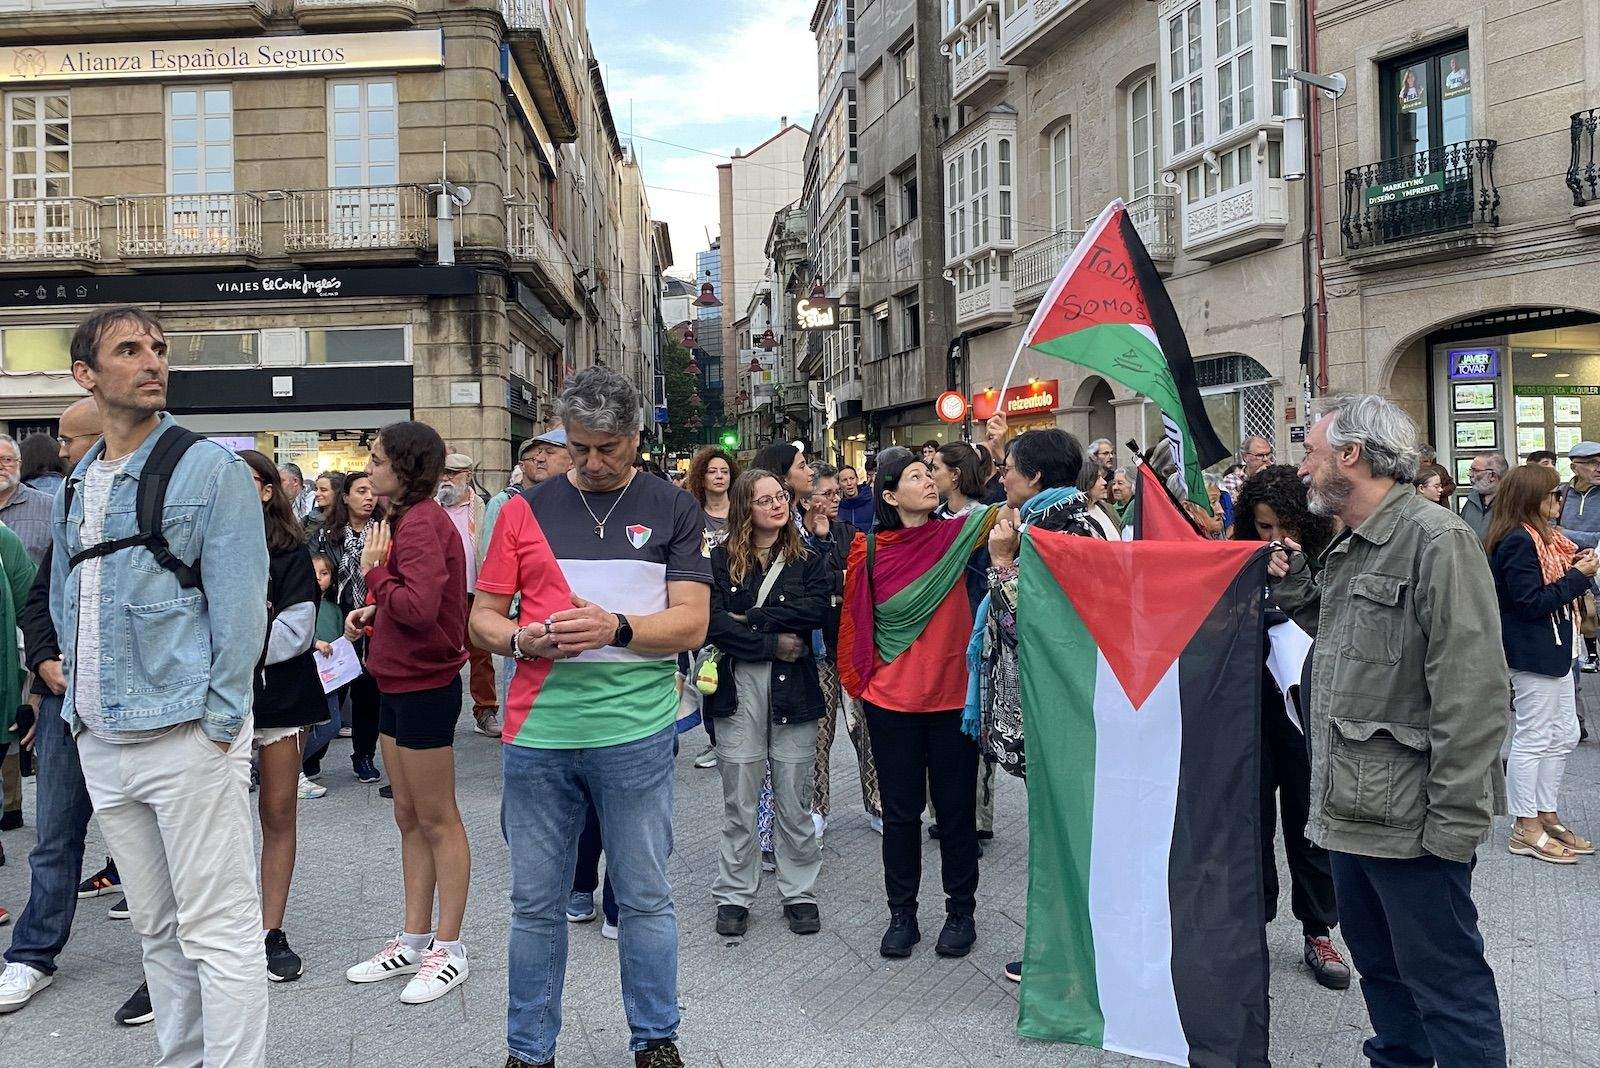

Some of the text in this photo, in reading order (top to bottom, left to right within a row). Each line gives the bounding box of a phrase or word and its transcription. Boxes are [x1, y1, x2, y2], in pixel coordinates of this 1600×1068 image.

[59, 44, 345, 74] Alianza Española Seguros
[216, 281, 260, 293] VIAJES
[262, 277, 275, 291] El
[274, 277, 302, 291] Corte
[1461, 353, 1489, 365] JAVIER
[1458, 364, 1486, 375] TOVAR
[1008, 389, 1053, 411] reizentolo
